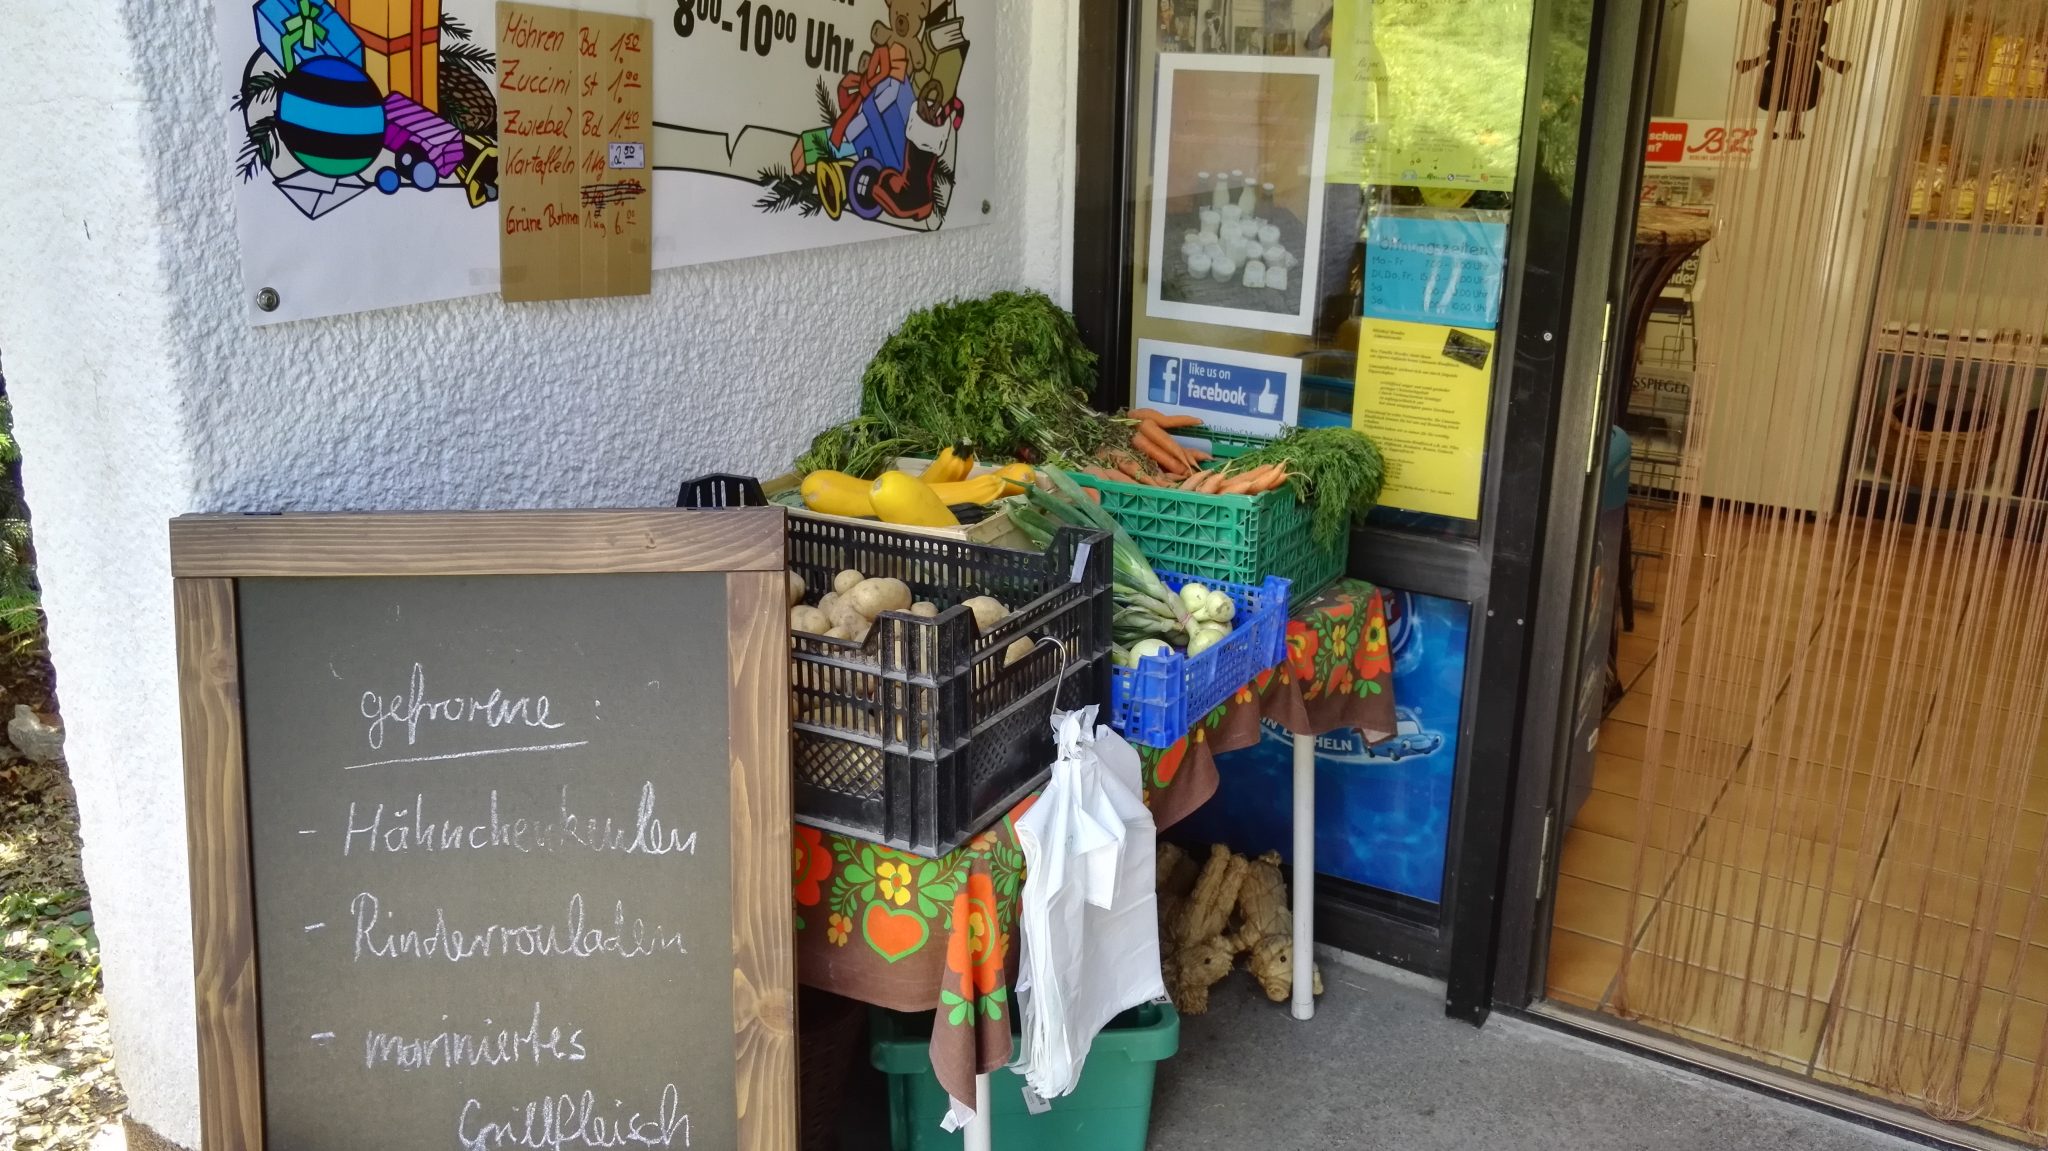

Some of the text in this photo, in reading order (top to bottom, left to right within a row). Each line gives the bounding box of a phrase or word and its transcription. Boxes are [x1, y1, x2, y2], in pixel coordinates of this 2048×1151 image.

[502, 11, 565, 52] Möhren
[579, 26, 600, 58] Bd
[805, 18, 855, 76] Uhr
[500, 59, 573, 96] Zuccini
[504, 106, 572, 139] Zwiebel
[581, 110, 603, 138] Bd
[1649, 131, 1683, 142] schon
[506, 205, 543, 236] Grüne
[1188, 361, 1231, 380] like us on
[1187, 378, 1247, 406] facebook
